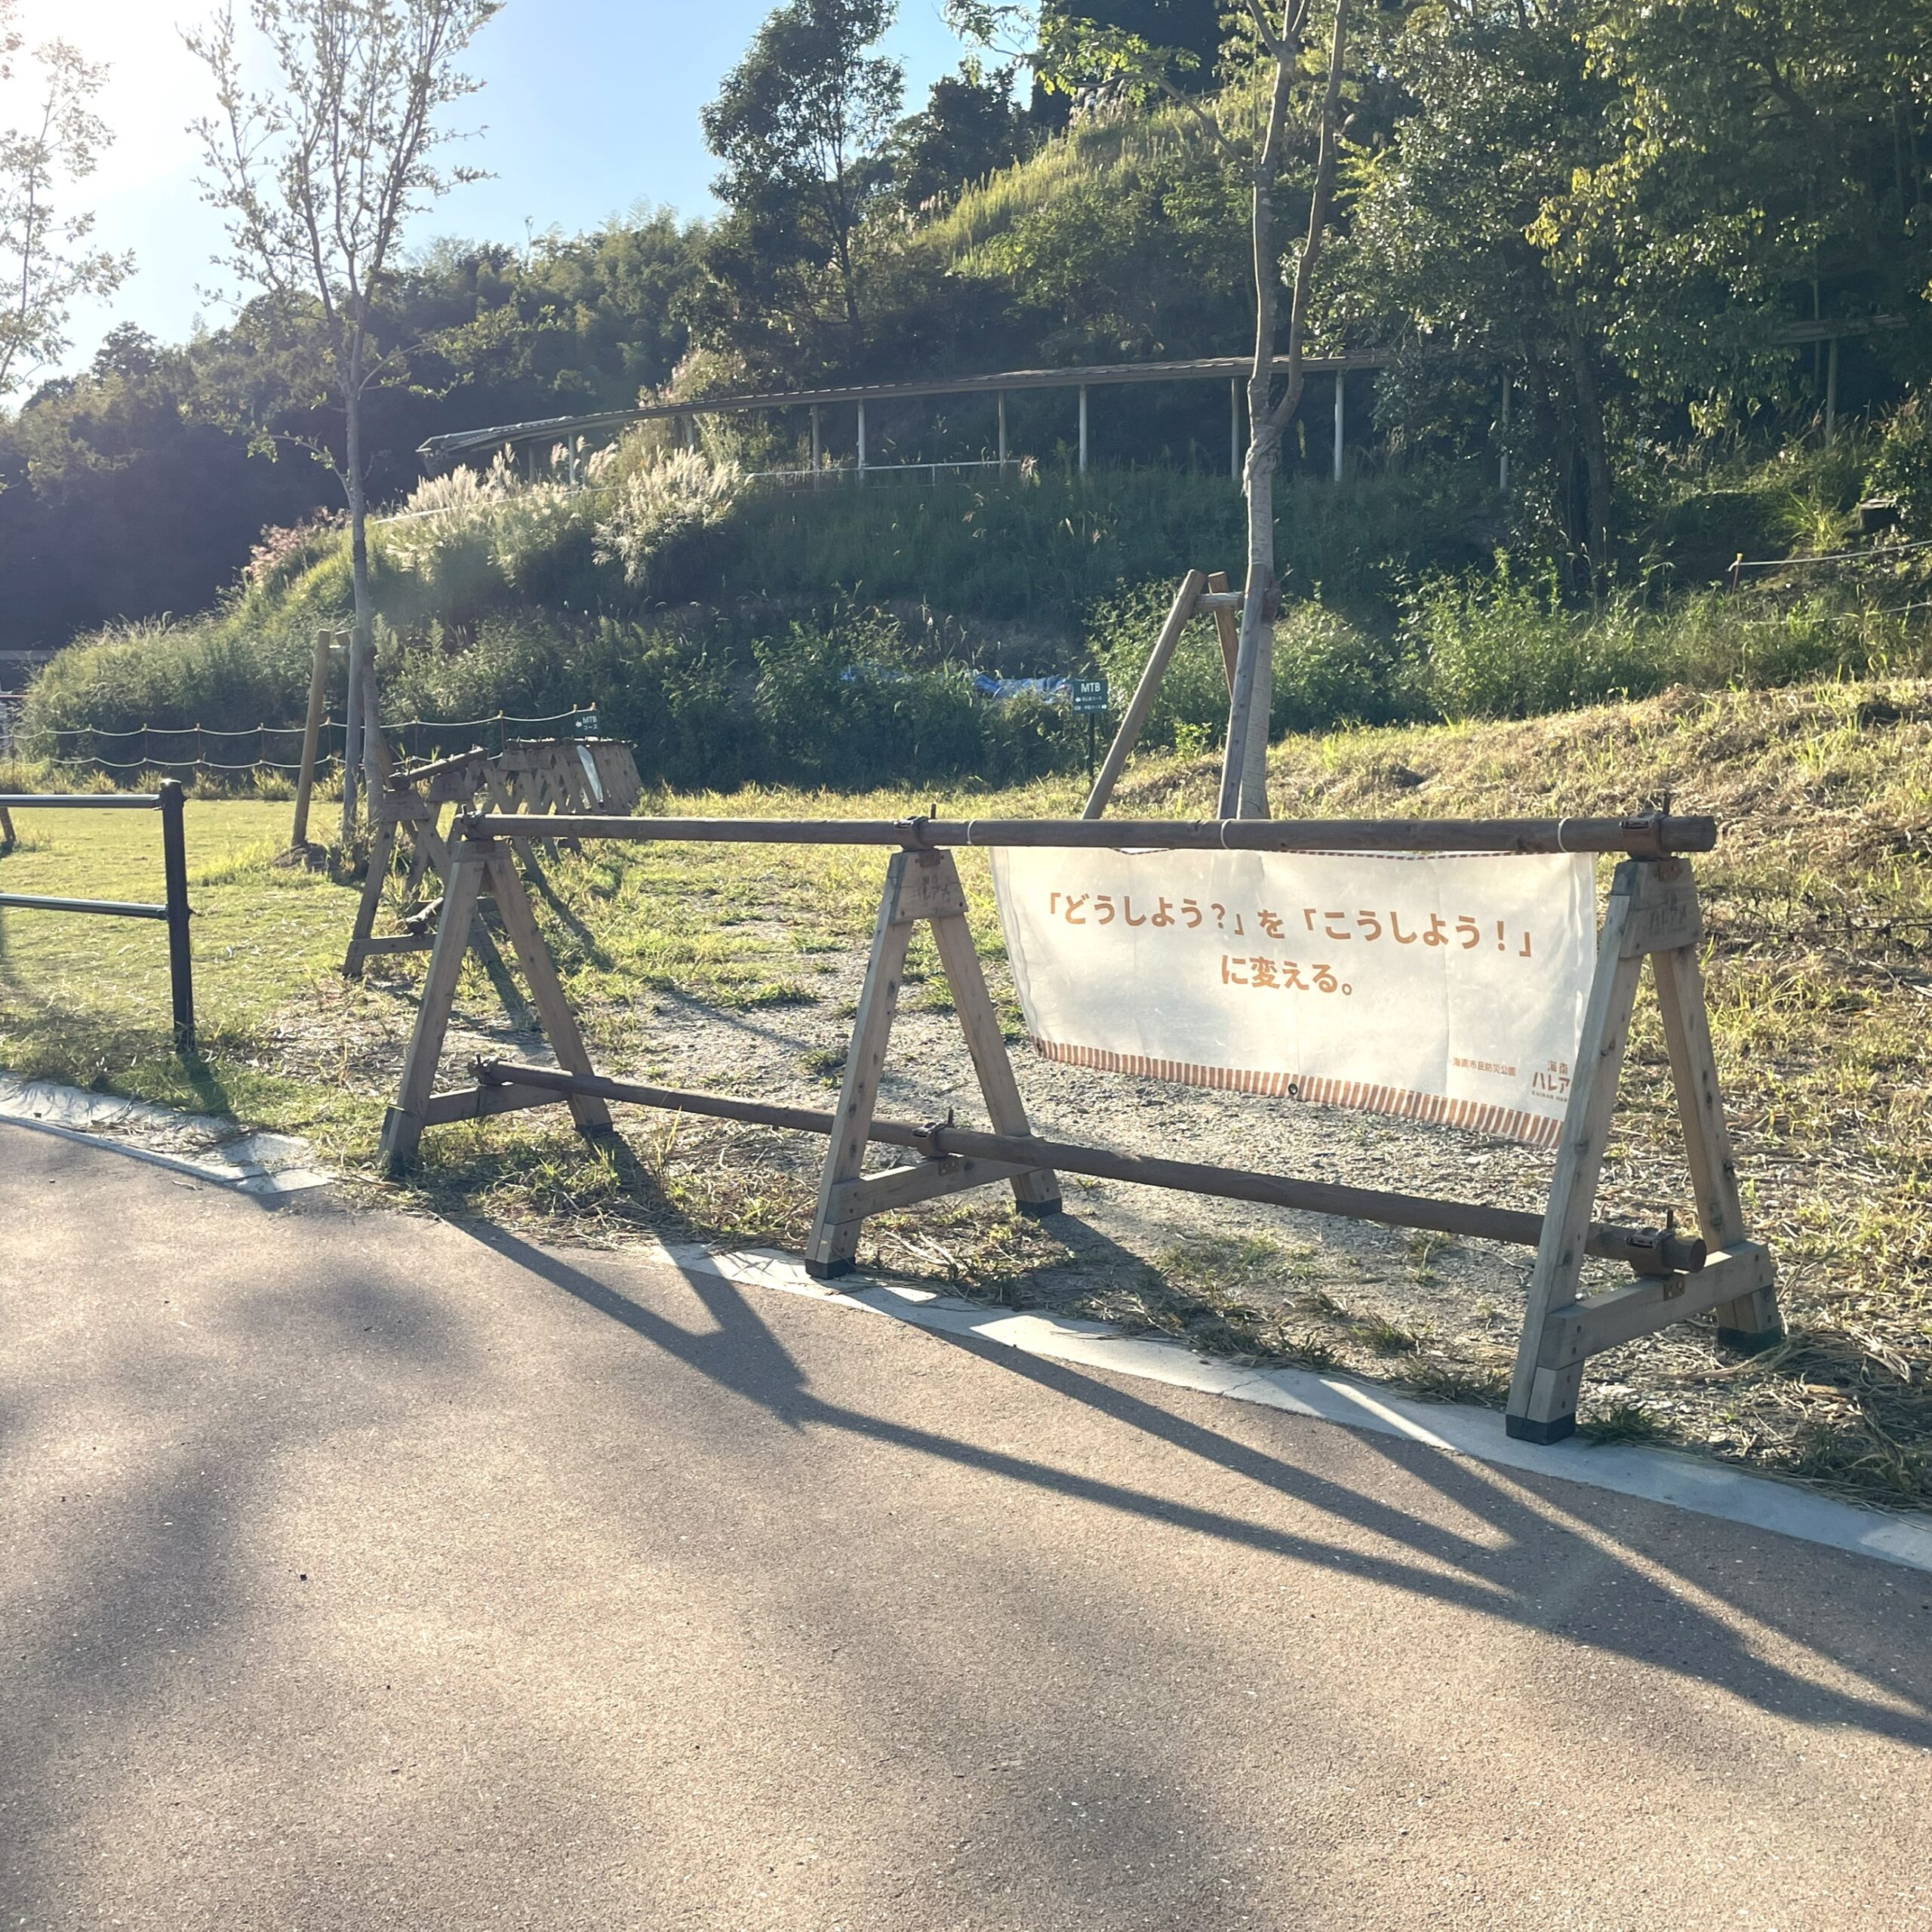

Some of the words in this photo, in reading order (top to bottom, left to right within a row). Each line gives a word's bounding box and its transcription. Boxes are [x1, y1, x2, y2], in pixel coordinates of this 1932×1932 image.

[1081, 682, 1101, 693] MTB
[1221, 955, 1352, 996] に変える。
